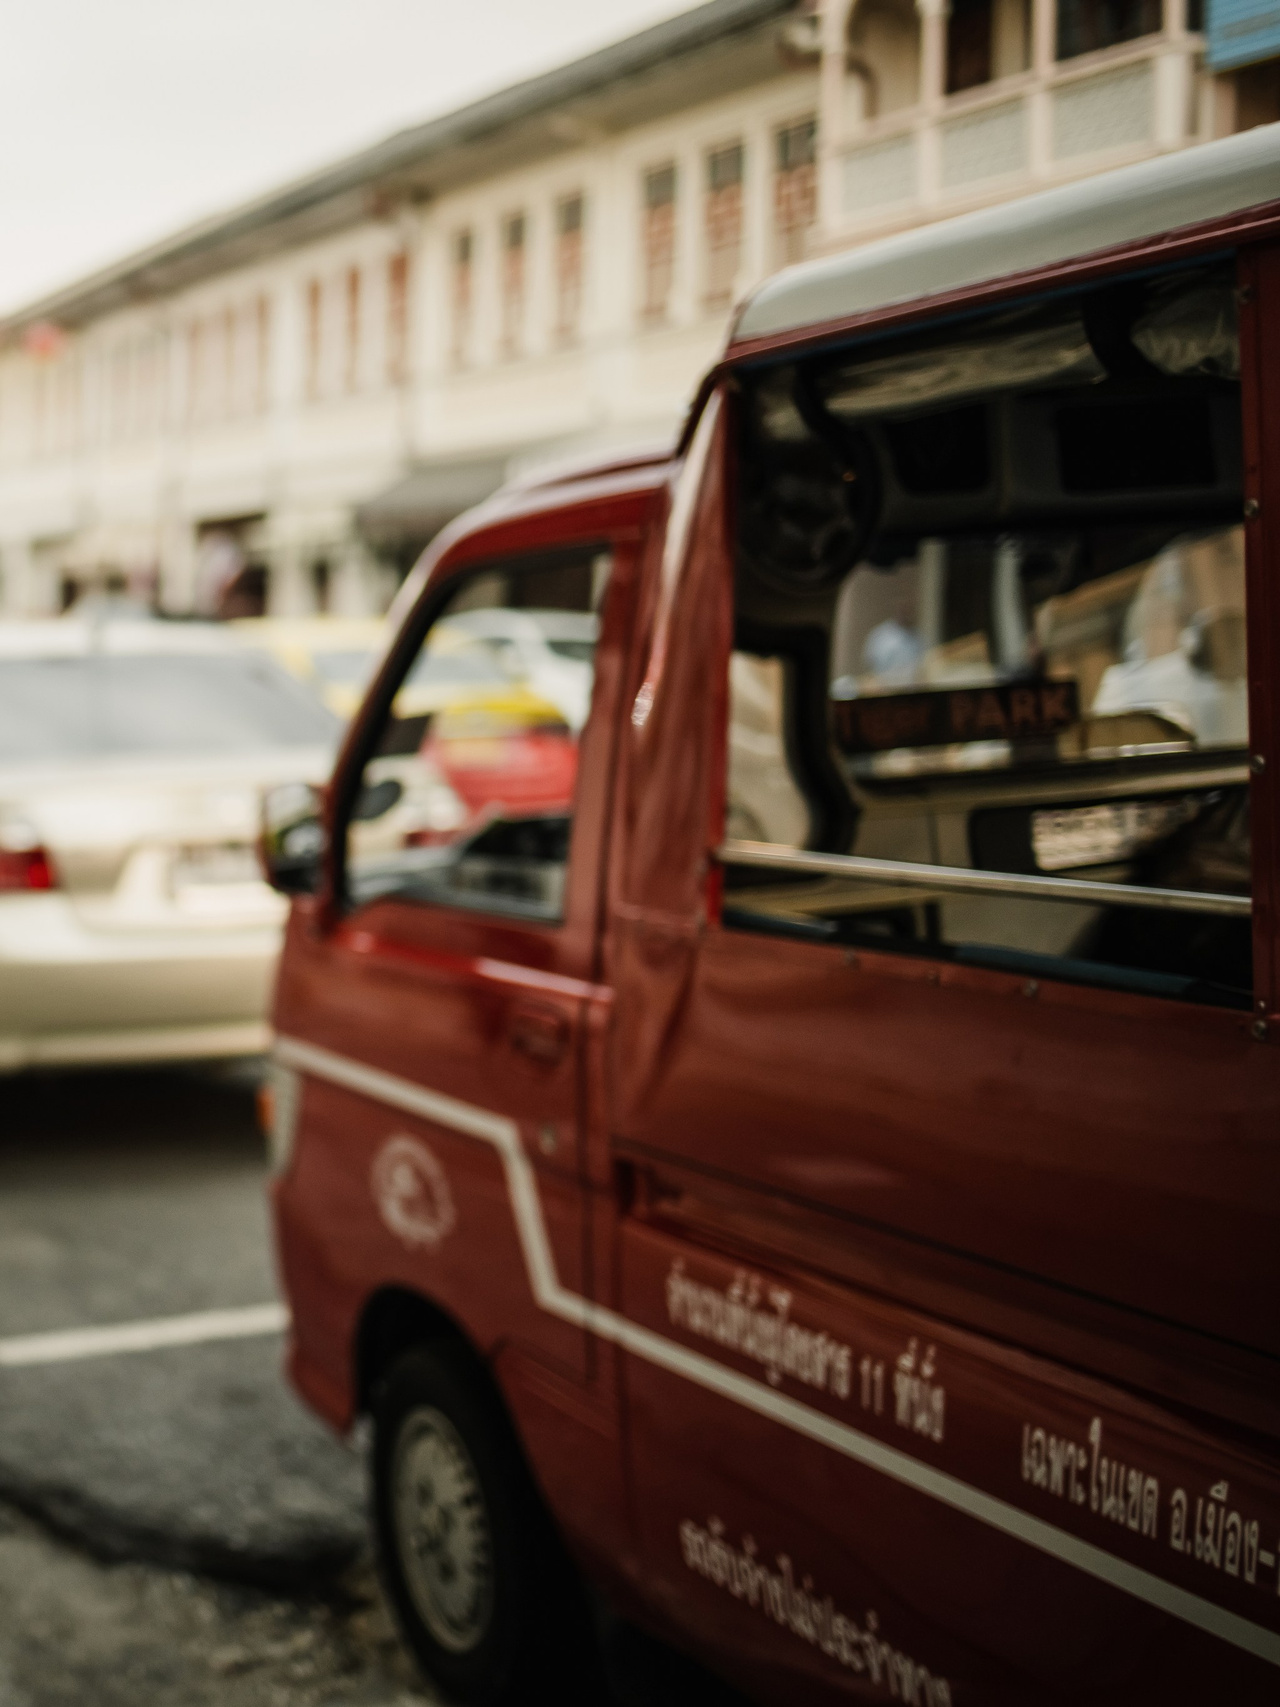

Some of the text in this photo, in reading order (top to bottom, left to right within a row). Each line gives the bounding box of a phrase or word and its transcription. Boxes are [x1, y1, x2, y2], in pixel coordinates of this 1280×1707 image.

[859, 1353, 886, 1417] 11
[1021, 1416, 1280, 1597] เฉพาะในเขต อ.เมือง-
